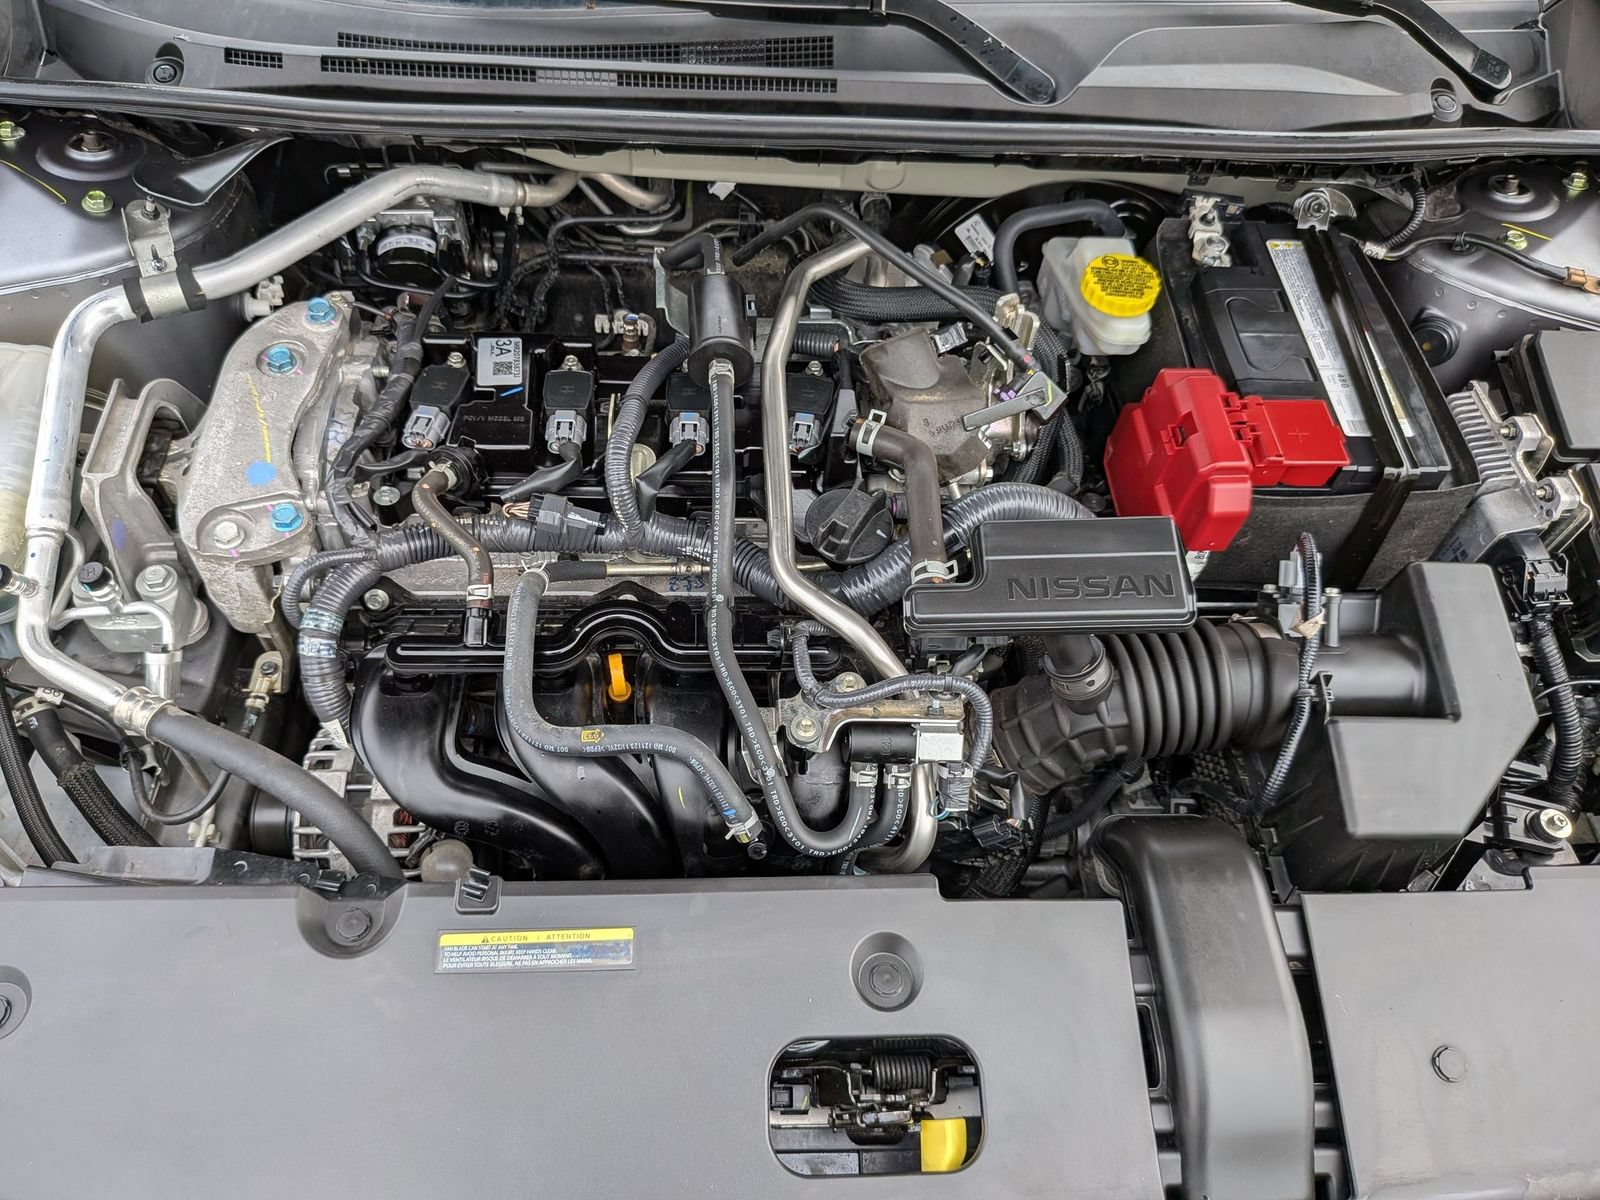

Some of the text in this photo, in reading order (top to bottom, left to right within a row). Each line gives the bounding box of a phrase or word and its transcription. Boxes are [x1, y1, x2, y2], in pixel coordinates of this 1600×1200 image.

[496, 340, 512, 357] 3A
[1006, 573, 1176, 600] NISSAN
[546, 932, 591, 940] ATTENTION
